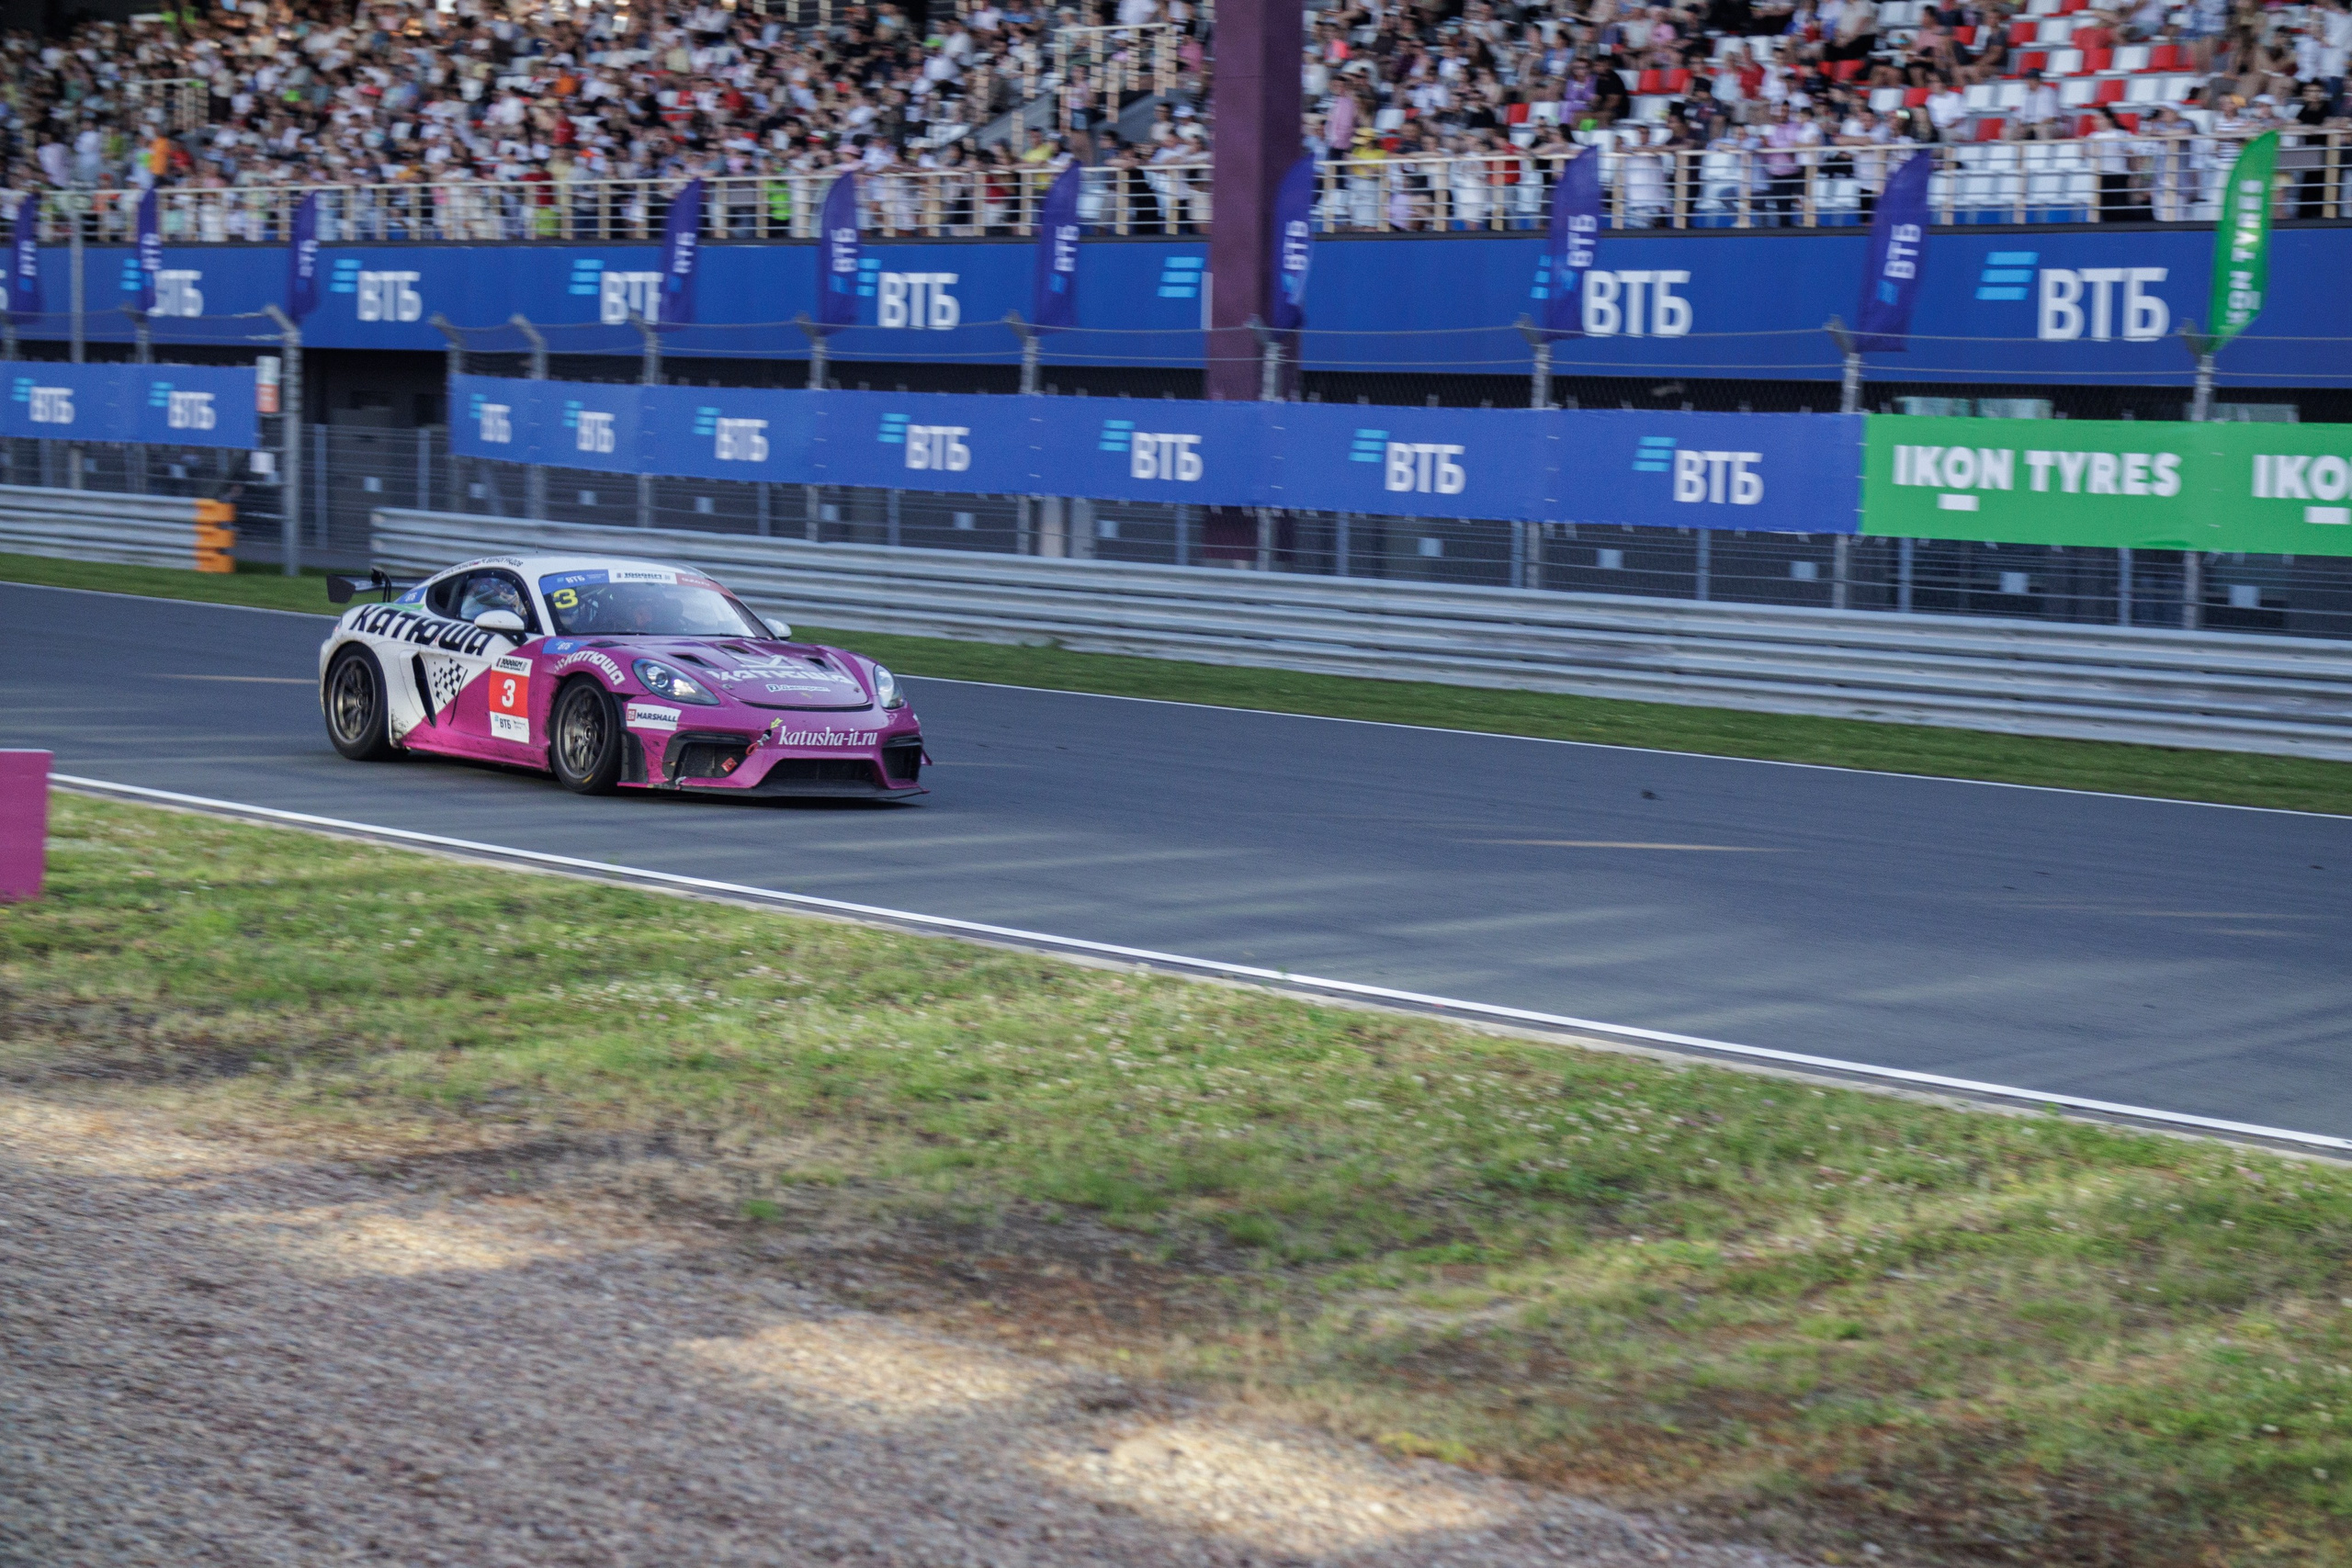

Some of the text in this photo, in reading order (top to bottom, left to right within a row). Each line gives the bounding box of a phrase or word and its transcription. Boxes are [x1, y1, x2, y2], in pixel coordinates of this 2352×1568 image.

[673, 232, 695, 274] ВТБ
[831, 228, 857, 272] ВТБ
[1054, 225, 1080, 272] ВТБ
[1283, 220, 1309, 270] ВТБ
[1566, 214, 1597, 267] ВТБ
[1883, 224, 1921, 278] ВТБ
[357, 271, 423, 321] ВТБ
[877, 272, 960, 330] ВТБ
[1582, 270, 1693, 338] ВТБ
[2037, 267, 2171, 342] ВТБ
[29, 387, 74, 424] ВТБ
[168, 391, 216, 430] ВТБ
[577, 412, 615, 453] ВТБ
[715, 417, 769, 461] ВТБ
[905, 424, 971, 471] ВТБ
[1131, 433, 1204, 482] ВТБ
[1385, 443, 1465, 494] ВТБ
[1673, 450, 1764, 504] ВТБ
[1893, 445, 2182, 497] IKON TYRES
[2252, 455, 2352, 501] IKO
[553, 589, 579, 609] 3
[565, 575, 586, 584] ВТБ
[502, 678, 515, 708] 3
[499, 717, 512, 729] ВТБ
[637, 711, 677, 723] MARSHALL
[778, 725, 878, 747] katusha-it.ru
